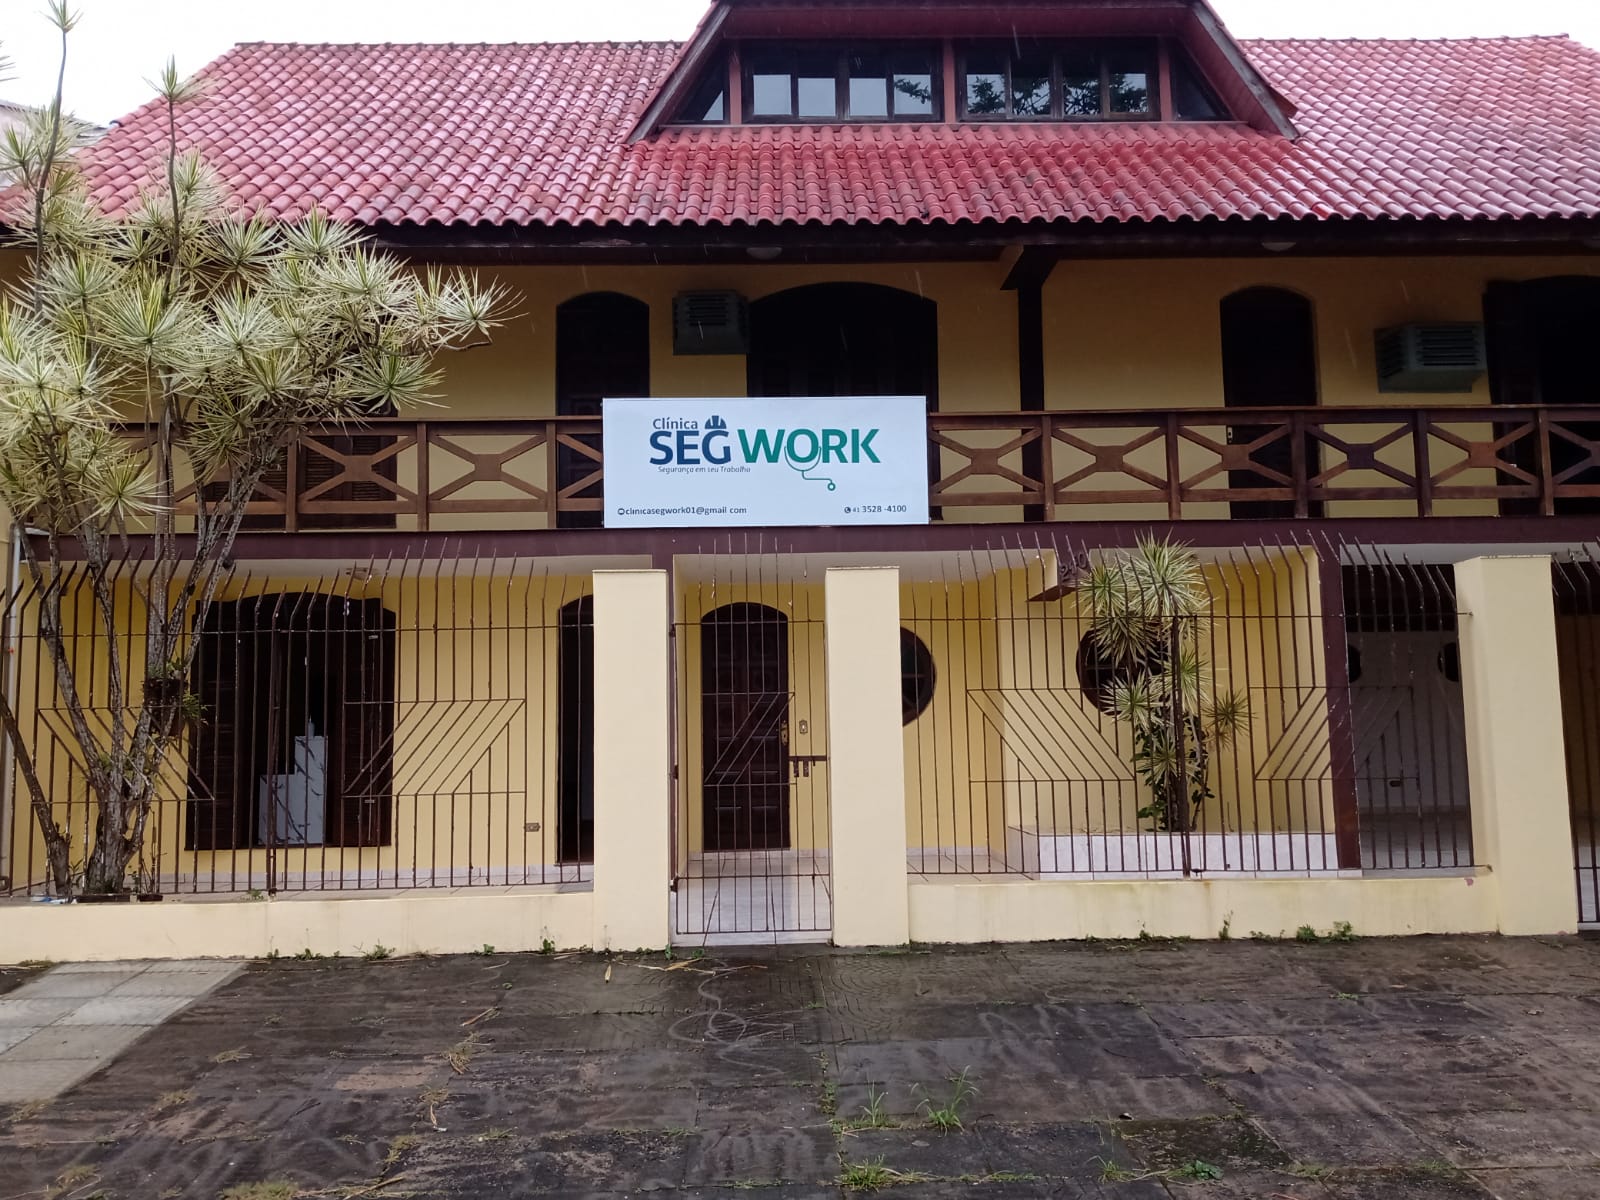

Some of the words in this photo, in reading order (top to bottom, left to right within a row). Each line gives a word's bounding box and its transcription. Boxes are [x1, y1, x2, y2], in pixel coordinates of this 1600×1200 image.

[653, 417, 698, 430] Clínica
[657, 466, 694, 475] Segurança
[862, 505, 882, 513] 3528
